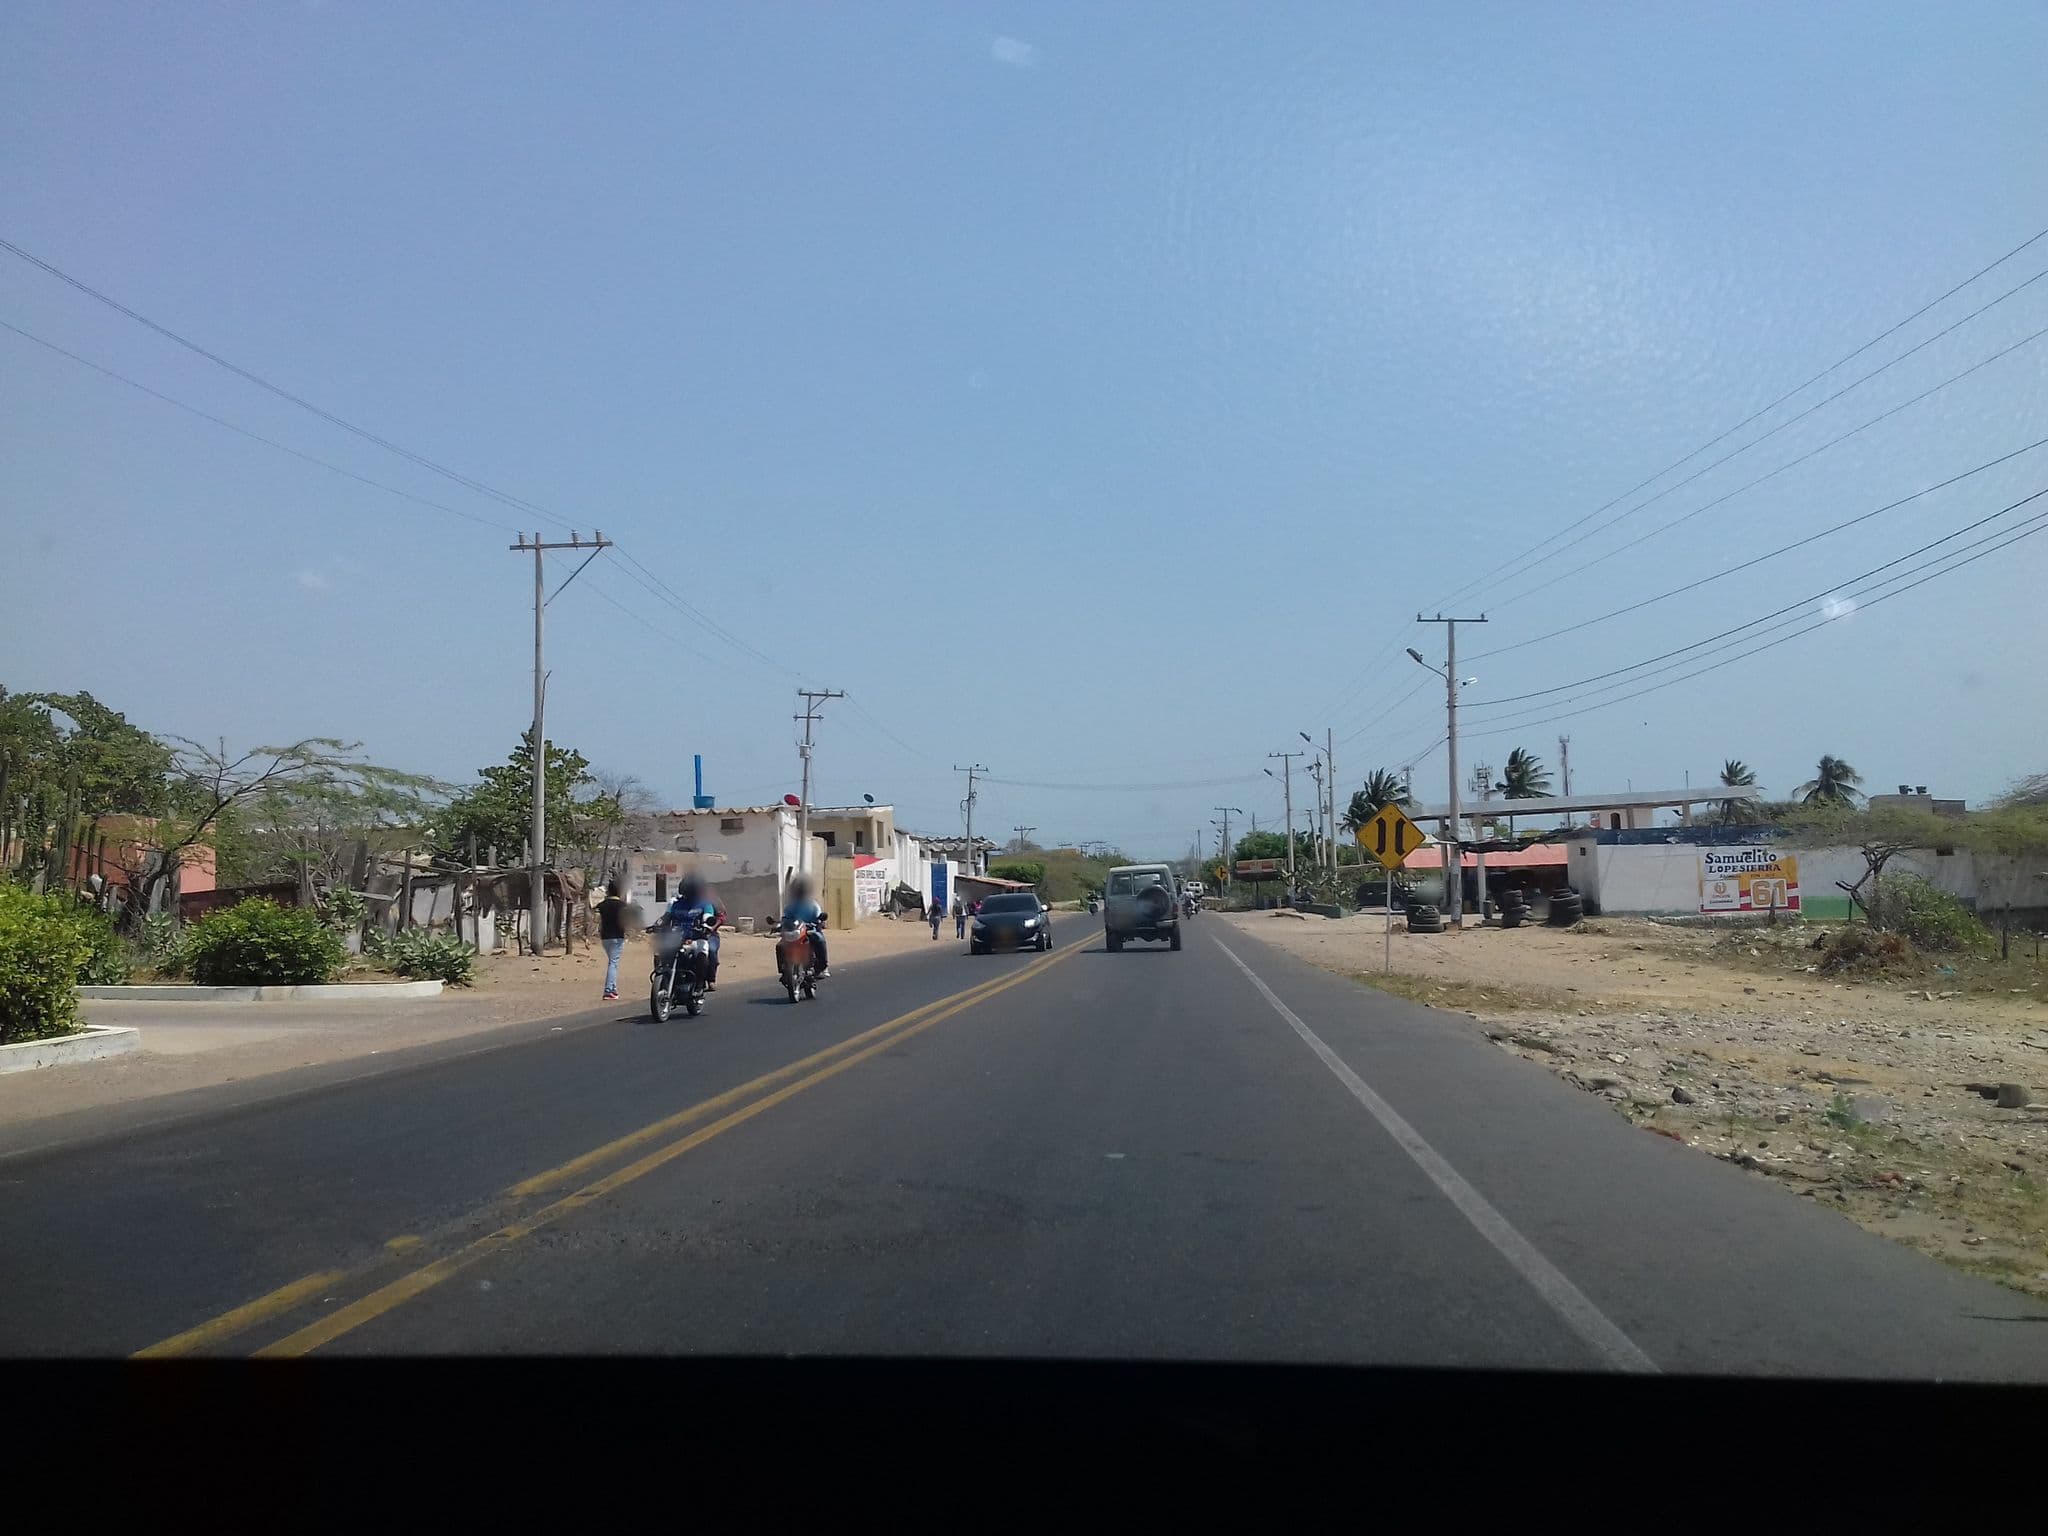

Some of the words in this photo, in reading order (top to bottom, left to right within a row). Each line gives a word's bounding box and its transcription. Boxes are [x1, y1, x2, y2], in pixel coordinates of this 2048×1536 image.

[1705, 849, 1777, 864] Samuelito
[1708, 864, 1781, 873] LOPESIERRA
[1752, 880, 1786, 906] 61
